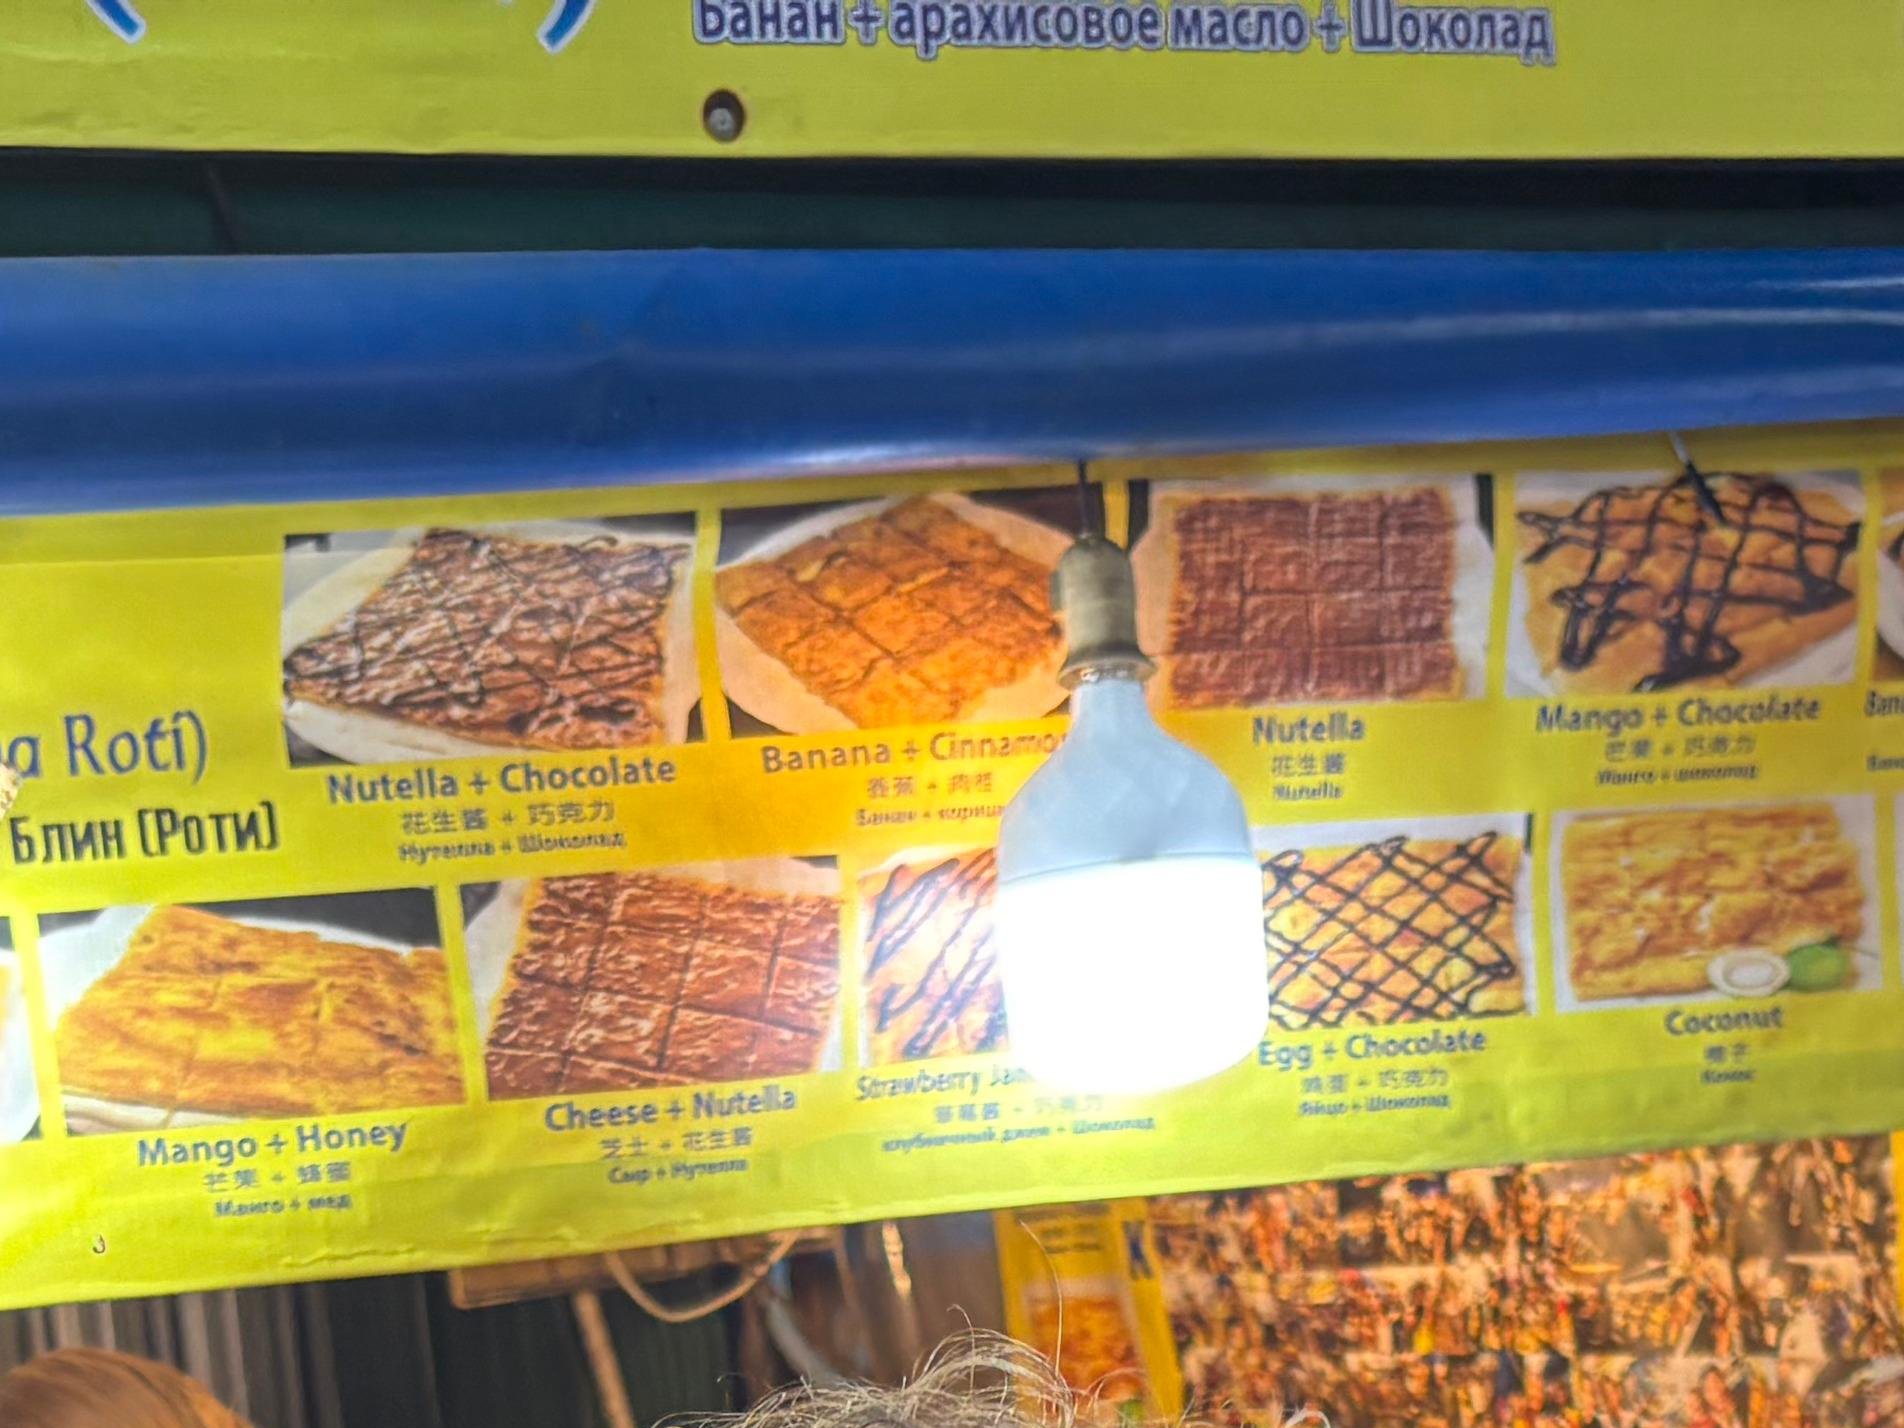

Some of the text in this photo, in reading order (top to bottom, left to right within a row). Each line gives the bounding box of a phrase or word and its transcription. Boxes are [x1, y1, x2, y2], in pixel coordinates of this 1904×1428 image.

[696, 0, 841, 43] Банан
[896, 6, 1161, 58] арахисовое
[1171, 10, 1303, 50] масло
[1351, 1, 1552, 63] Шоколад
[1252, 711, 1367, 745] Nutella
[1536, 704, 1643, 737] Mango
[1678, 694, 1821, 727] Chocolate
[63, 708, 209, 786] Roti)
[761, 740, 893, 774] Banana
[929, 731, 1068, 761] Cinnamo
[327, 767, 459, 804] Nutella
[499, 755, 678, 794] Chocolate
[9, 812, 127, 864] Блин
[1664, 1006, 1784, 1036] Coconut
[1258, 1041, 1314, 1070] Egg
[1347, 1029, 1486, 1058] Chocolate
[856, 1069, 982, 1101] Strawberry
[545, 1101, 658, 1132] Cheese
[693, 1084, 797, 1119] Nutella
[137, 1137, 258, 1167] Mango
[296, 1122, 408, 1152] Honey
